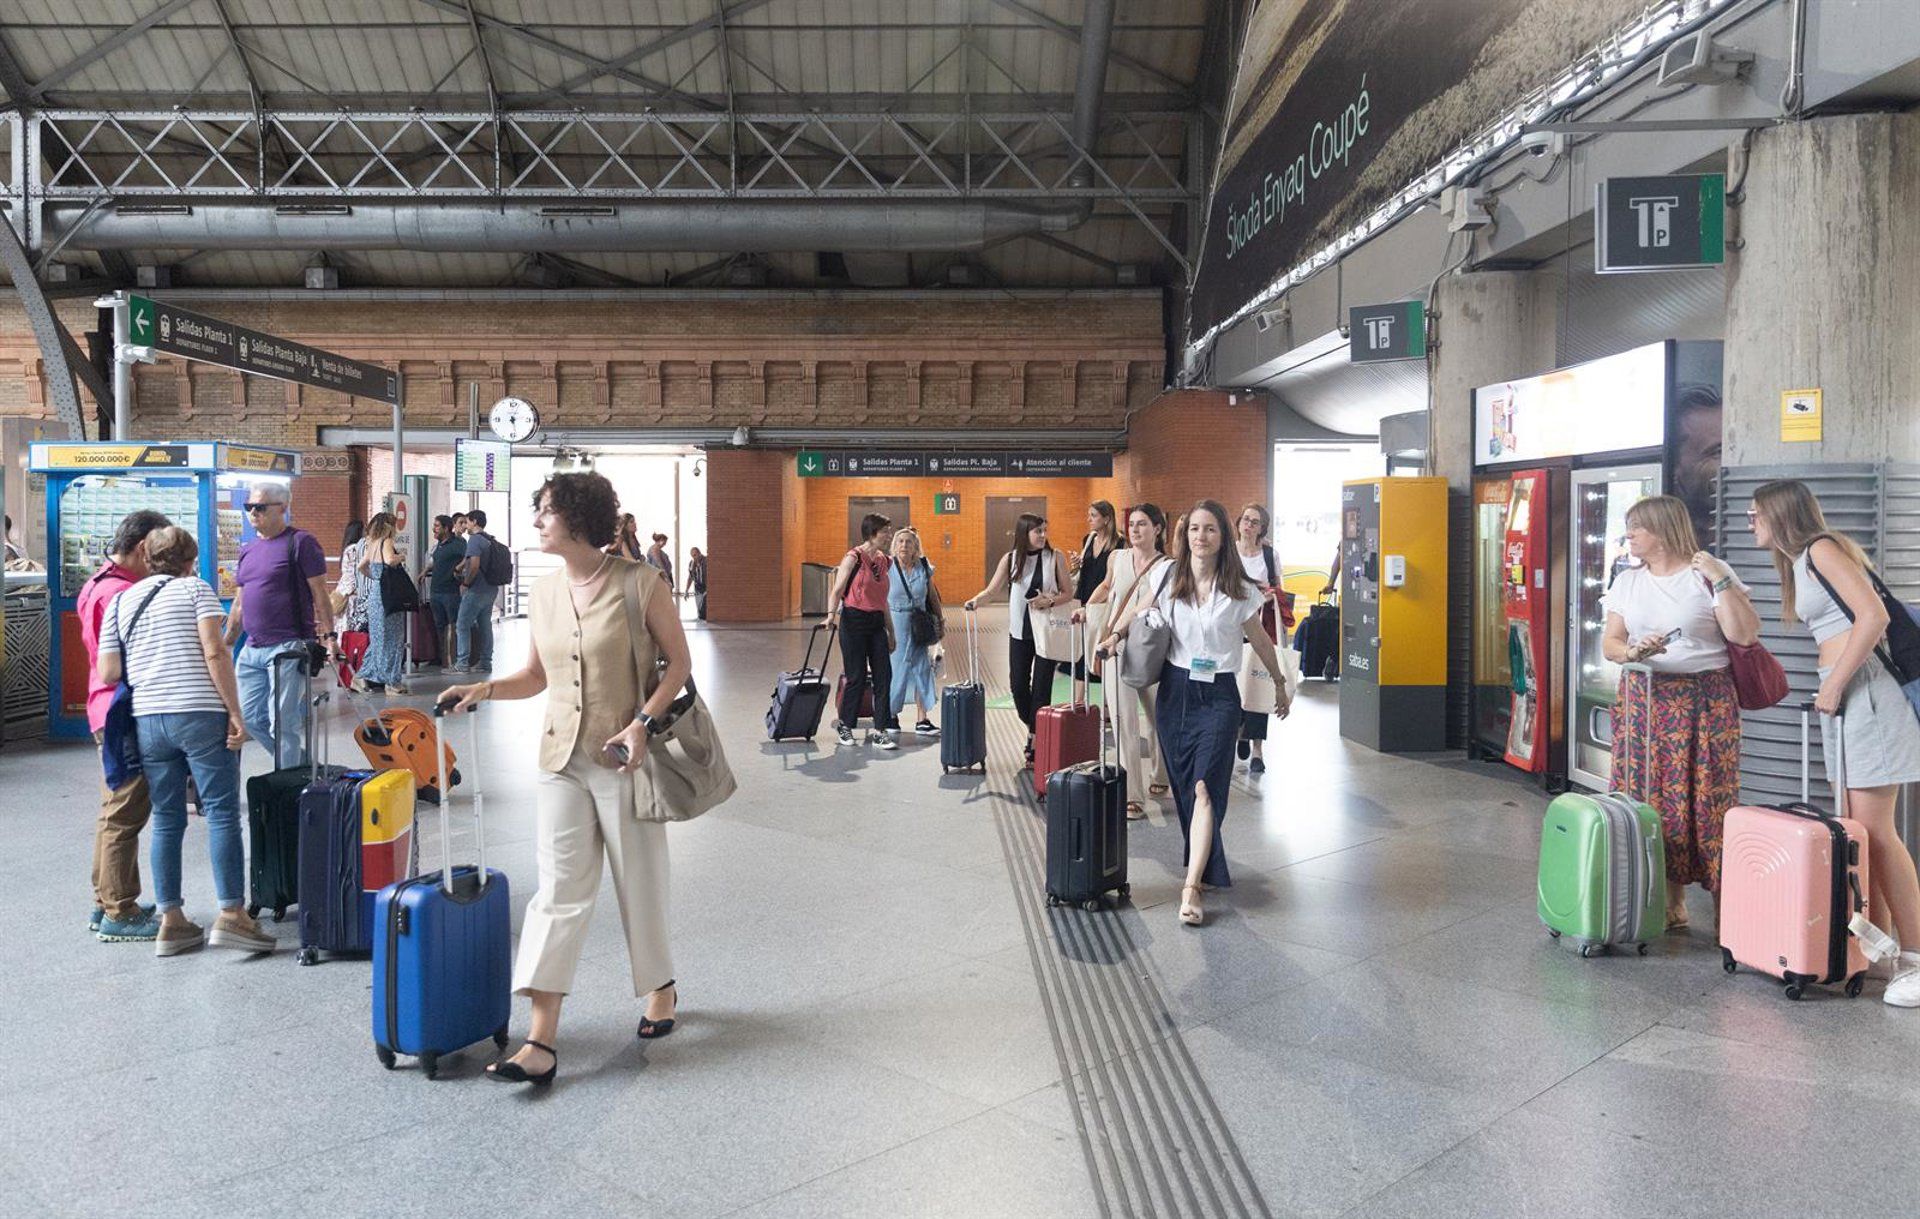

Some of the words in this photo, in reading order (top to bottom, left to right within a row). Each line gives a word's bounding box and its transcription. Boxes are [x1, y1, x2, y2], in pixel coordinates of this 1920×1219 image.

[1226, 192, 1261, 260] Škoda
[1264, 153, 1305, 224] Enyaq
[1309, 72, 1370, 180] Coupé
[1656, 229, 1667, 245] P
[175, 317, 203, 338] Salidas
[204, 325, 227, 344] Planta
[226, 332, 234, 346] 1
[251, 338, 274, 357] Salidas
[274, 345, 294, 362] Planta
[294, 350, 307, 367] Baja
[862, 458, 888, 466] Salidas
[889, 458, 912, 466] Planta
[914, 458, 919, 466] 1
[943, 458, 968, 466] Salidas
[982, 458, 998, 468] Baja
[1026, 457, 1058, 466] Atención
[1059, 458, 1066, 466] al
[1067, 458, 1092, 466] cliente
[1348, 652, 1369, 671] saba.es
